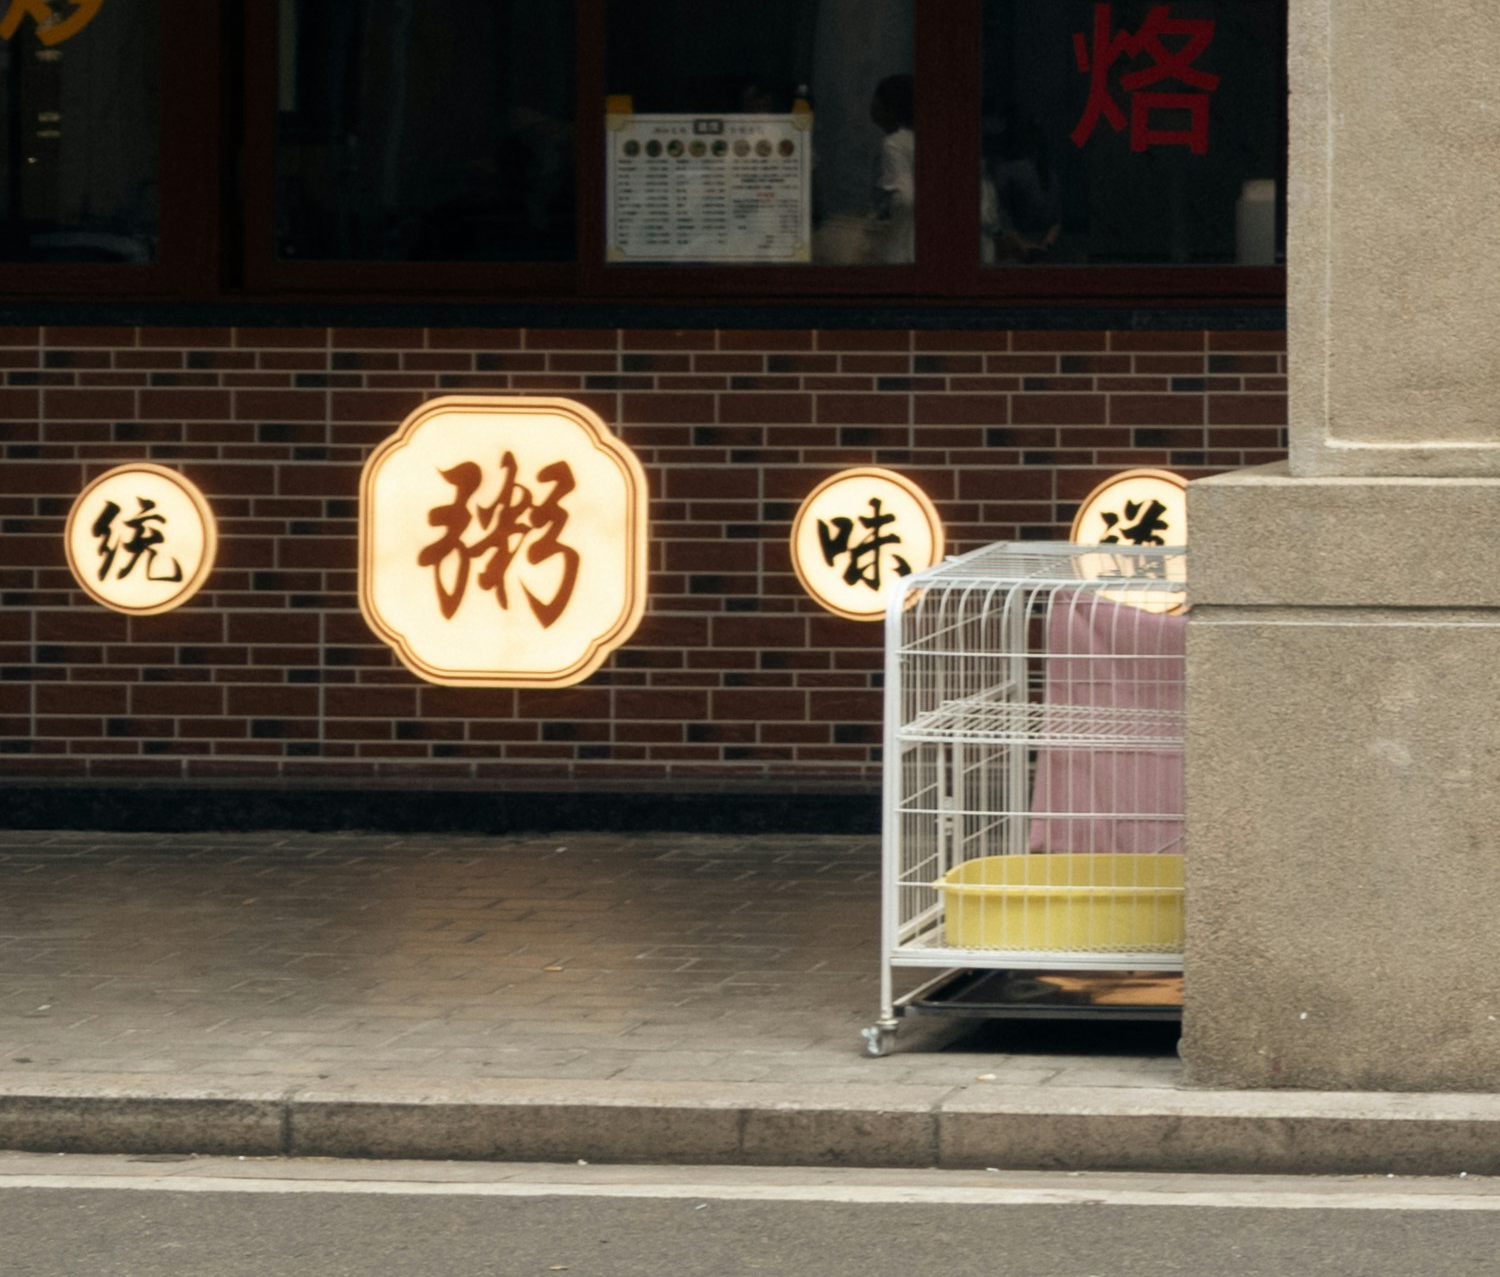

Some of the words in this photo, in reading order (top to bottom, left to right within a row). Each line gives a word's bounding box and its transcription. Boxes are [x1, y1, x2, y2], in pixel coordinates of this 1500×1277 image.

[93, 498, 184, 584] 统
[418, 451, 583, 629] 粥
[819, 498, 911, 592] 味
